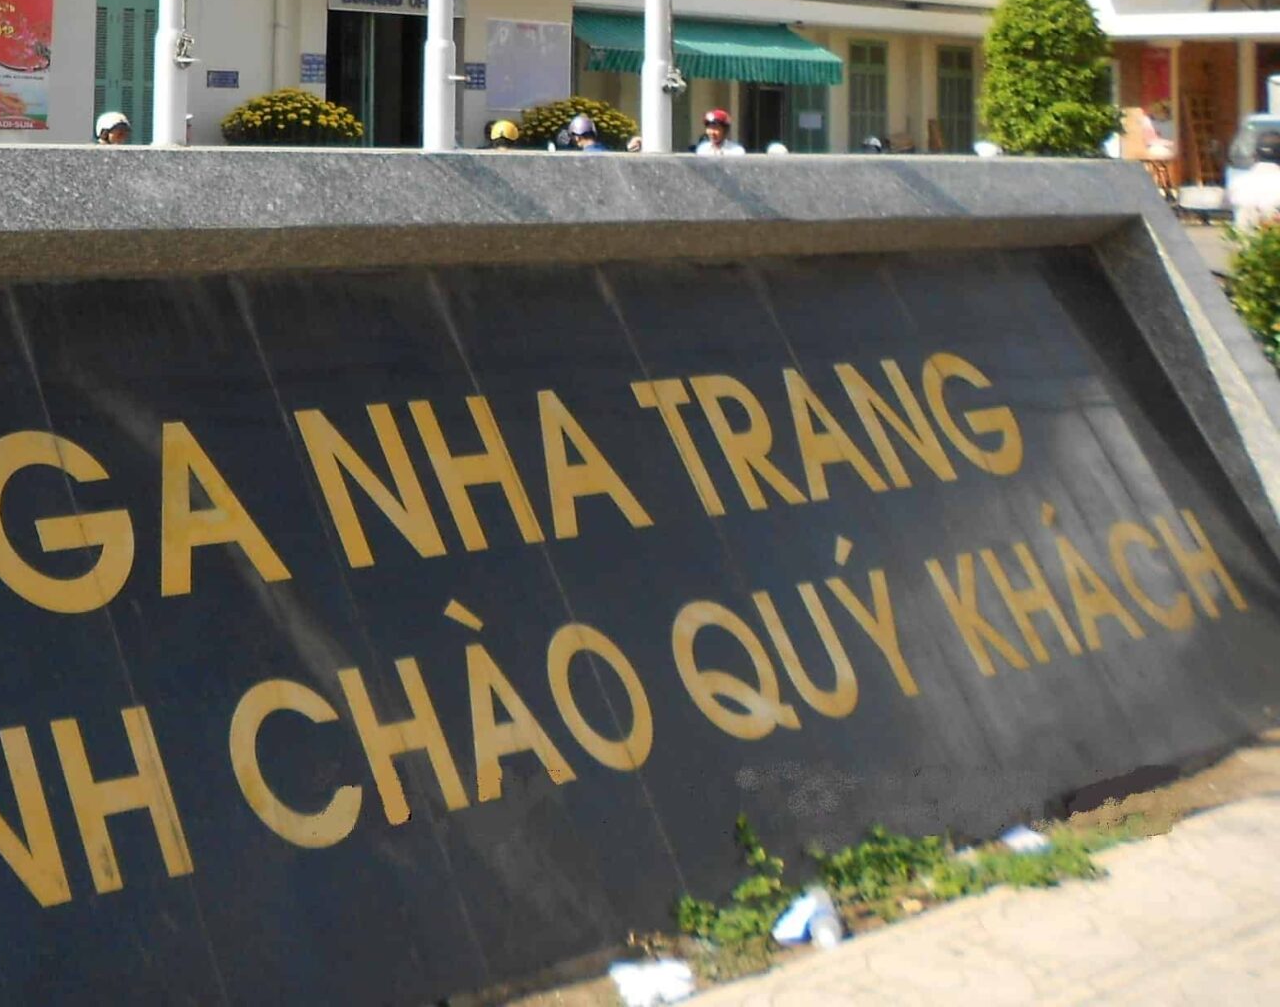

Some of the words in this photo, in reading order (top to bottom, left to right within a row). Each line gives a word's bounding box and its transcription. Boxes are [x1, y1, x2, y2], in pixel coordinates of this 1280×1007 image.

[293, 389, 655, 568] NHA
[630, 352, 1023, 516] TRANG
[229, 599, 654, 850] CHÀO
[672, 535, 920, 740] QUÝ
[925, 501, 1248, 677] KHÁCH
